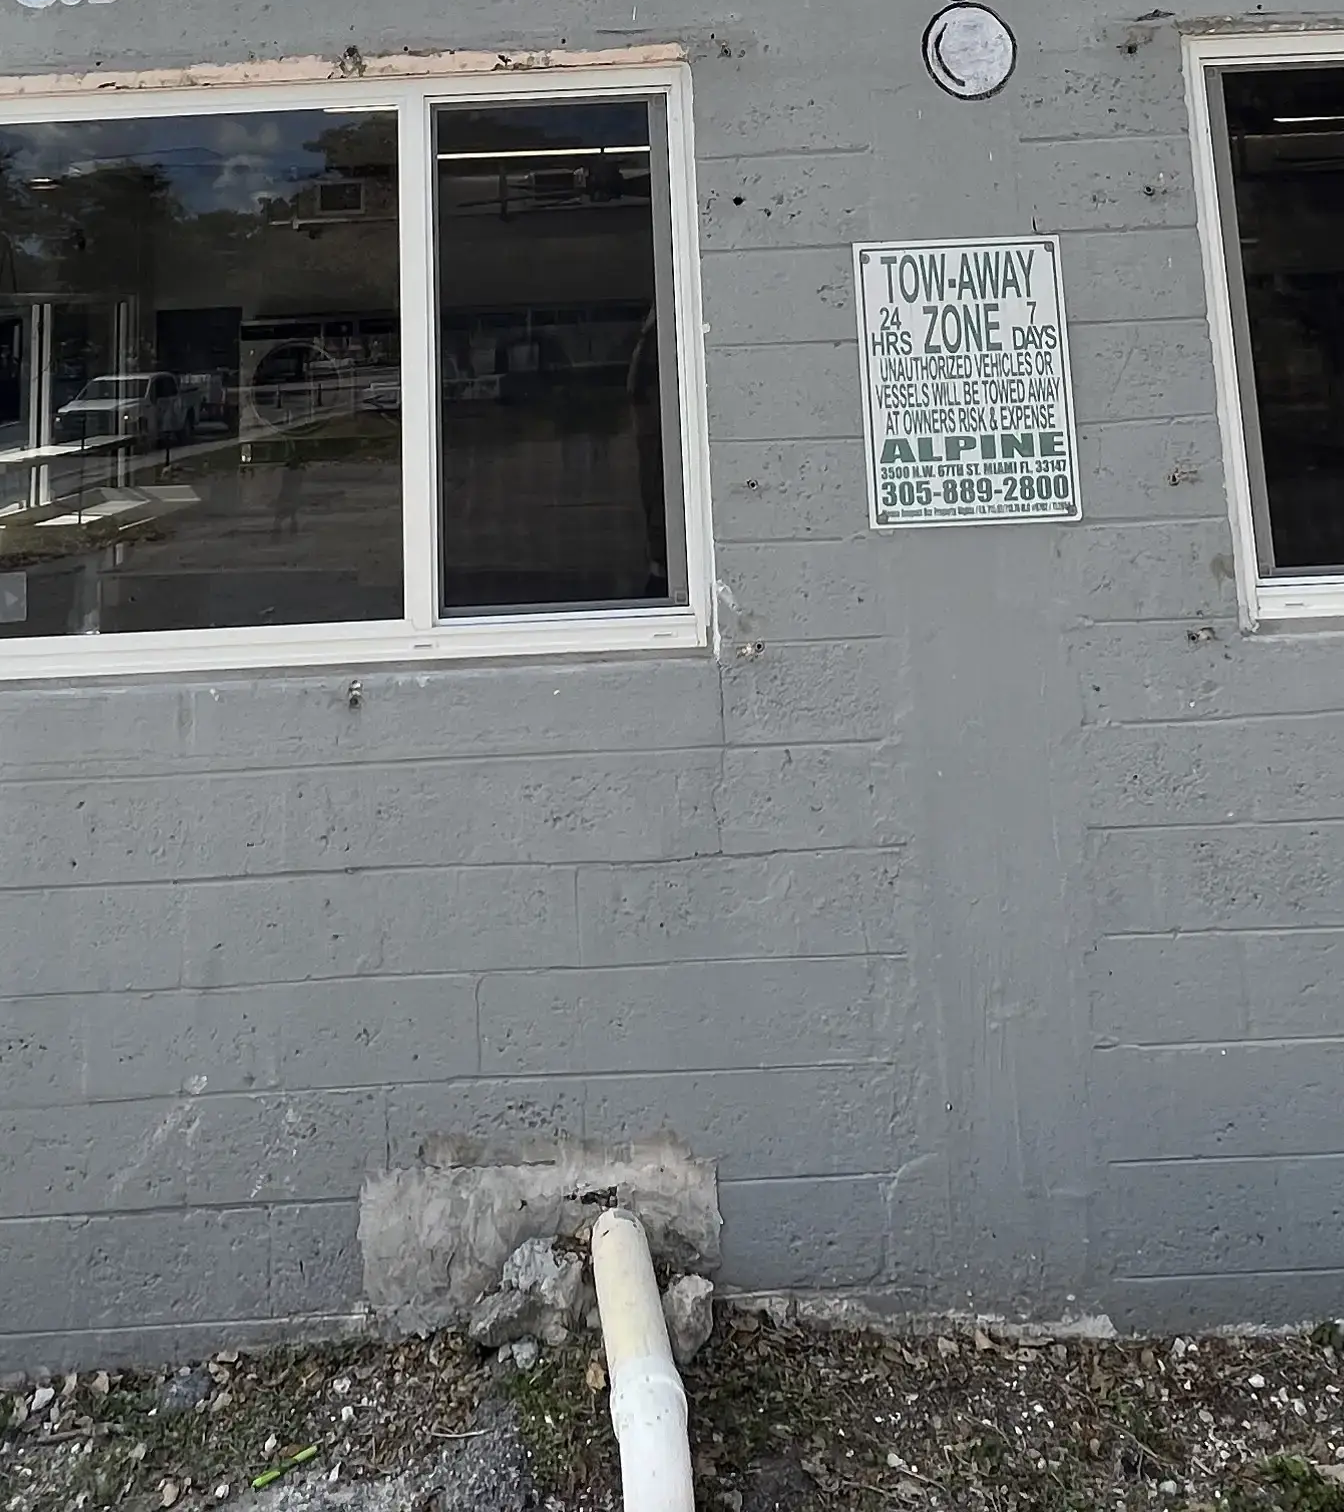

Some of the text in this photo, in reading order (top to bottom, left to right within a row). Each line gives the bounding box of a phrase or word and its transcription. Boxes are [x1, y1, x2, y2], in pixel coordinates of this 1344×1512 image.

[880, 249, 1035, 304] TOW-AWAY
[879, 307, 902, 331] 24
[922, 303, 1003, 354] ZONE
[1026, 301, 1037, 325] 7
[871, 331, 913, 356] HRS
[1012, 325, 1057, 351] DAYS
[879, 351, 1054, 382] UNAUTHORIZED VEHICLES OR
[875, 377, 1060, 409] VESSELS WILL BE TOWED AWAY
[886, 404, 1056, 436] AT OWNERS RISK & EXPENSE
[879, 431, 1067, 464] ALPINE
[881, 465, 910, 480] 3500
[983, 461, 1017, 475] MIAMI
[1035, 460, 1067, 473] 33147
[881, 474, 1069, 506] 305-889-2800
